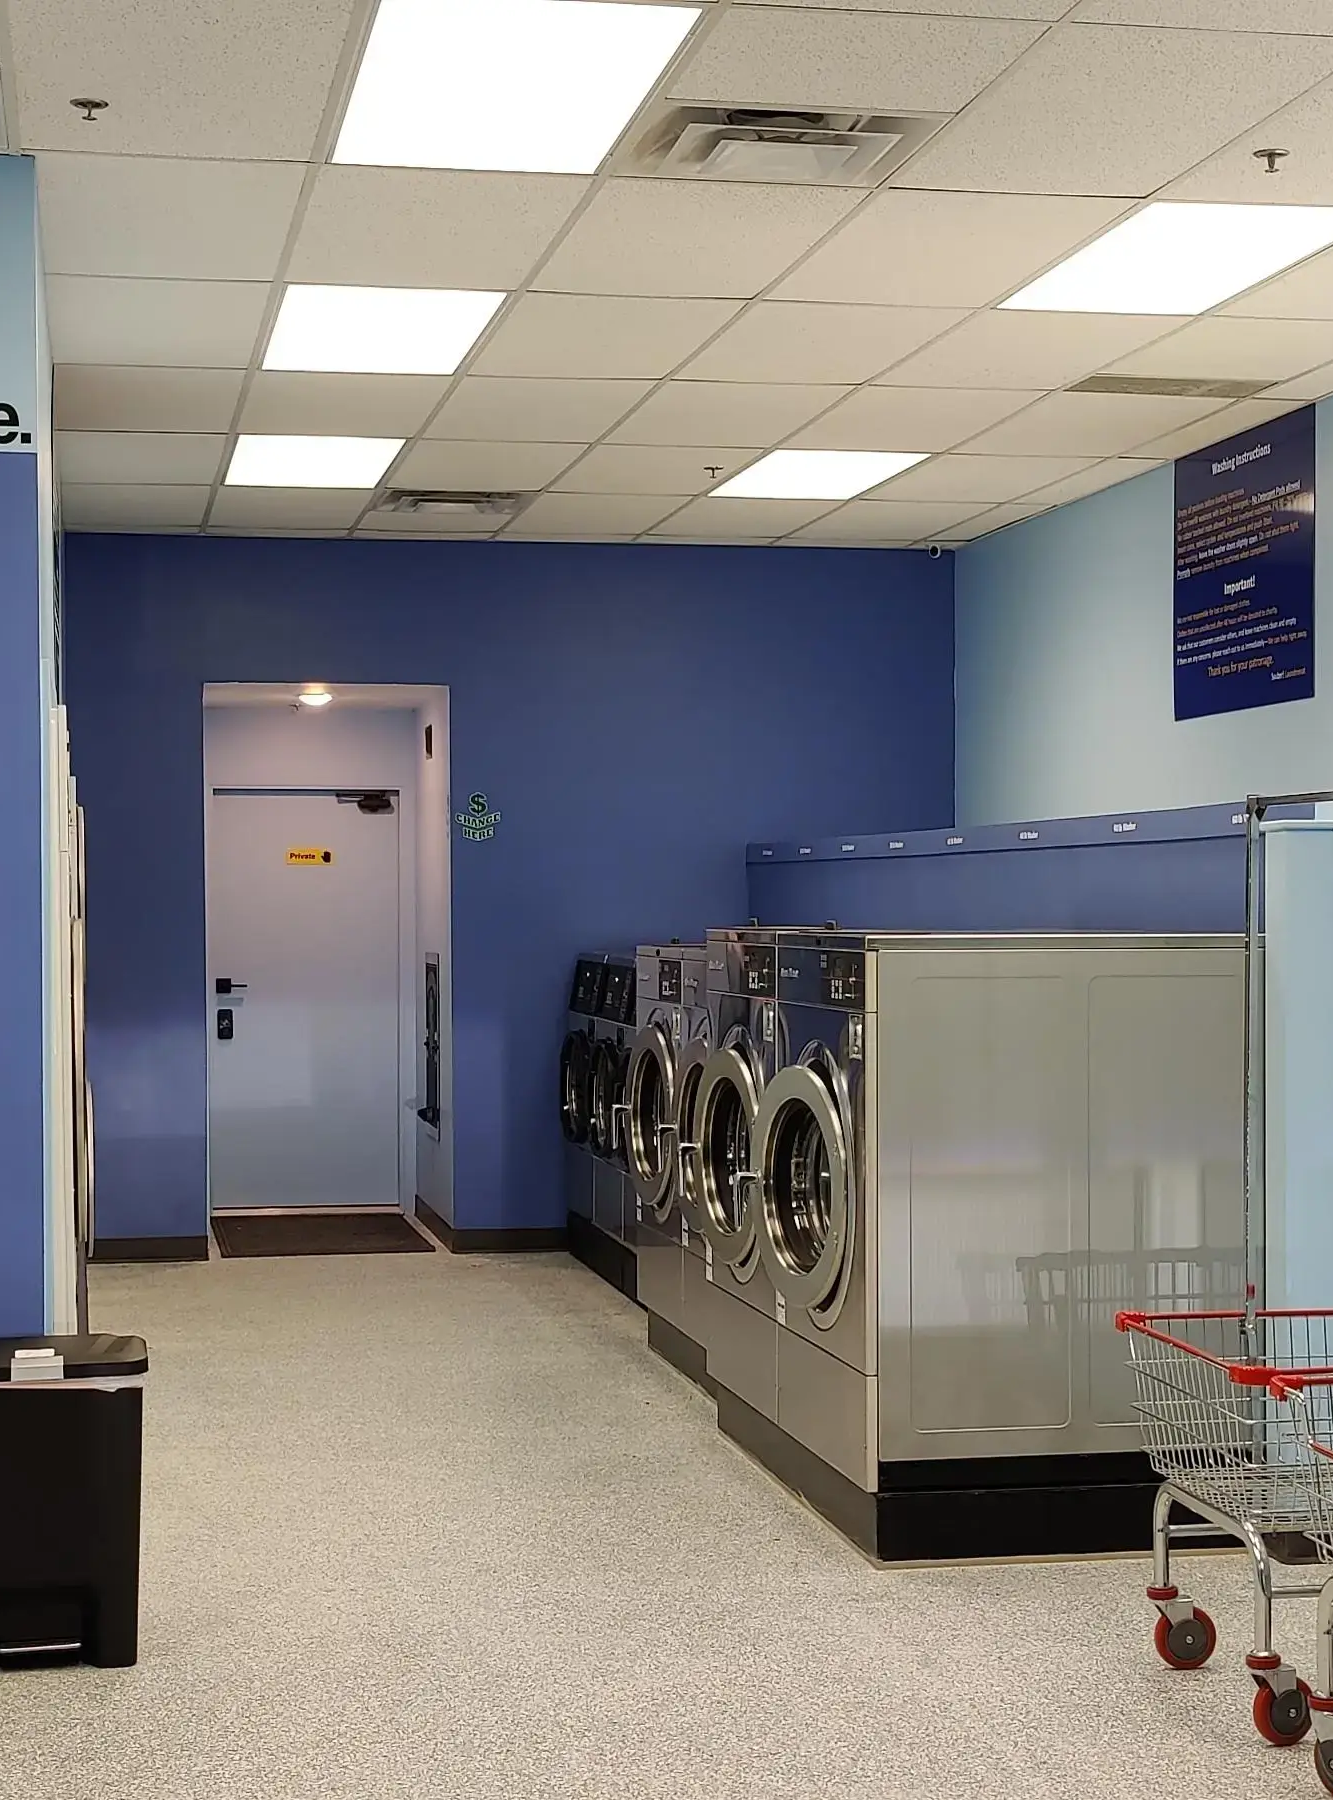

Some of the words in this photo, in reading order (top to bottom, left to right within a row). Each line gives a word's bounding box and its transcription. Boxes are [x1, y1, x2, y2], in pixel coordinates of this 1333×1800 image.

[1212, 456, 1236, 475] Washing
[1236, 443, 1271, 466] Instructions
[1224, 575, 1255, 596] Important!
[456, 812, 500, 827] CHANGE
[463, 828, 494, 840] HERE
[289, 852, 316, 860] Private
